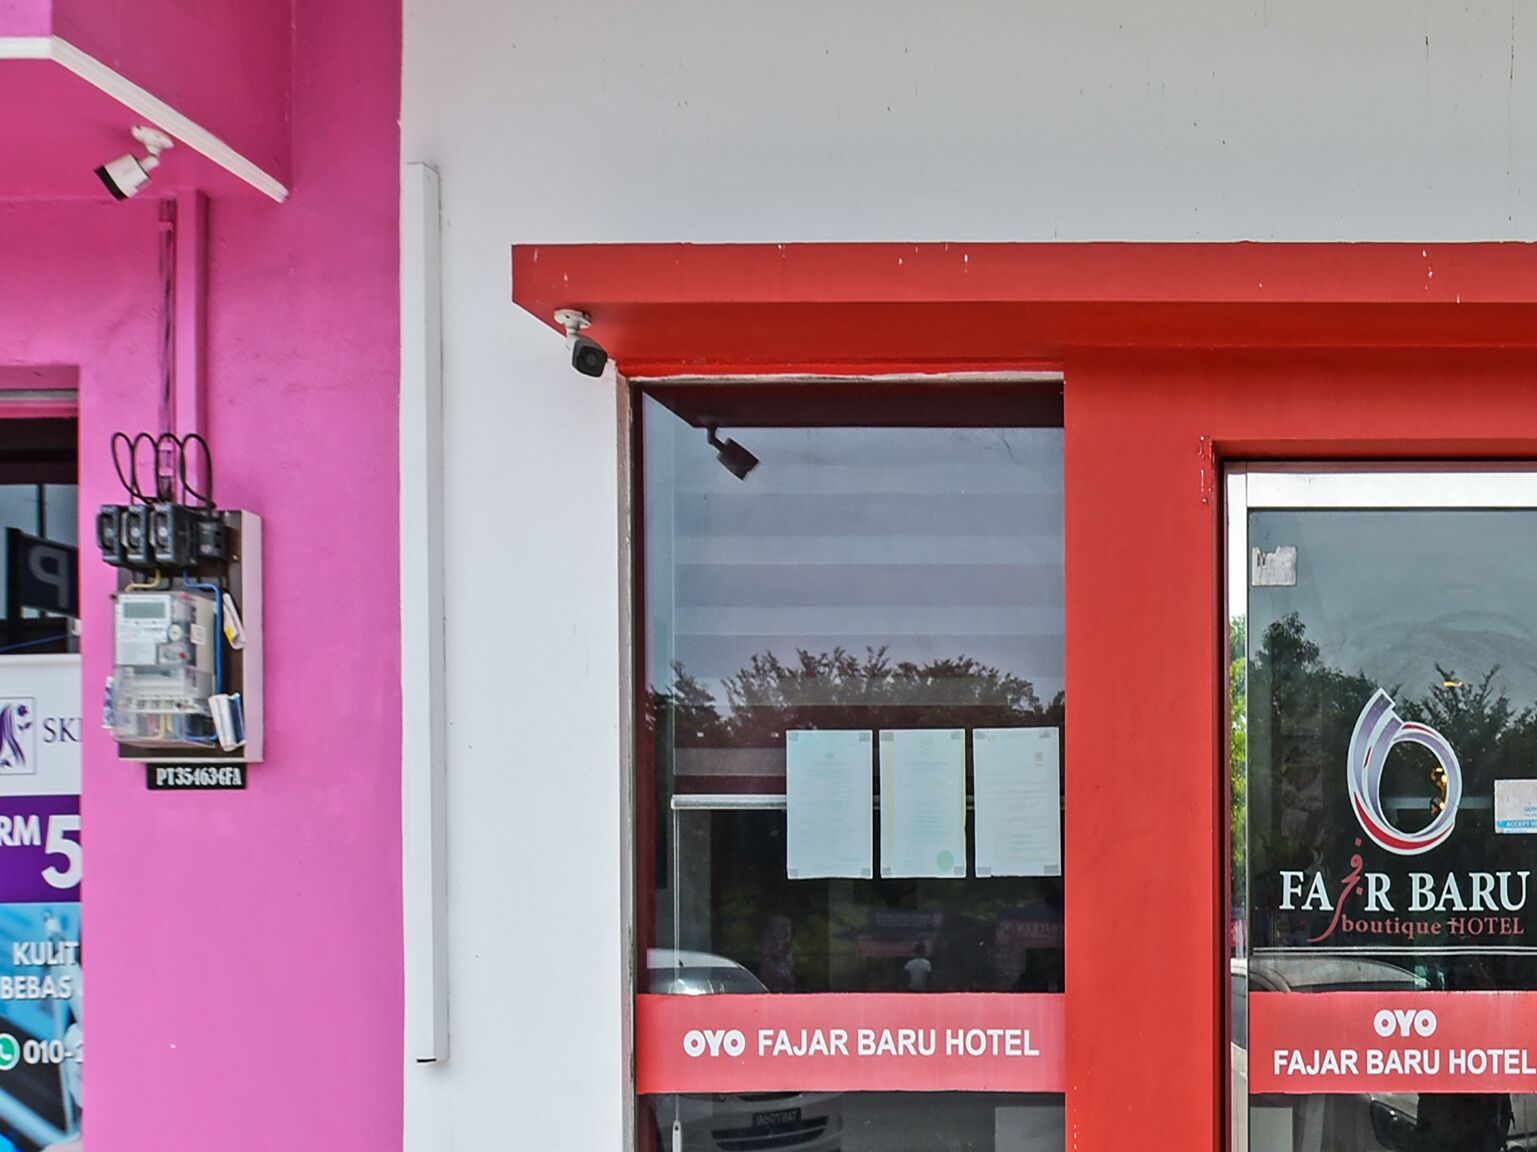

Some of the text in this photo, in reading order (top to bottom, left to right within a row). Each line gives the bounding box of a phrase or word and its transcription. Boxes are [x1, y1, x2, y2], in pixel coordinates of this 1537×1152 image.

[1408, 871, 1530, 912] BARU
[1341, 914, 1525, 940] boutique HOTEL
[13, 941, 79, 965] KULIT
[0, 975, 72, 999] BEBAS
[1373, 1009, 1437, 1037] OYO
[683, 1028, 1040, 1057] OYO FAJAR BARU HOTEL
[1274, 1048, 1537, 1075] FAJAR BARU HOTEL
